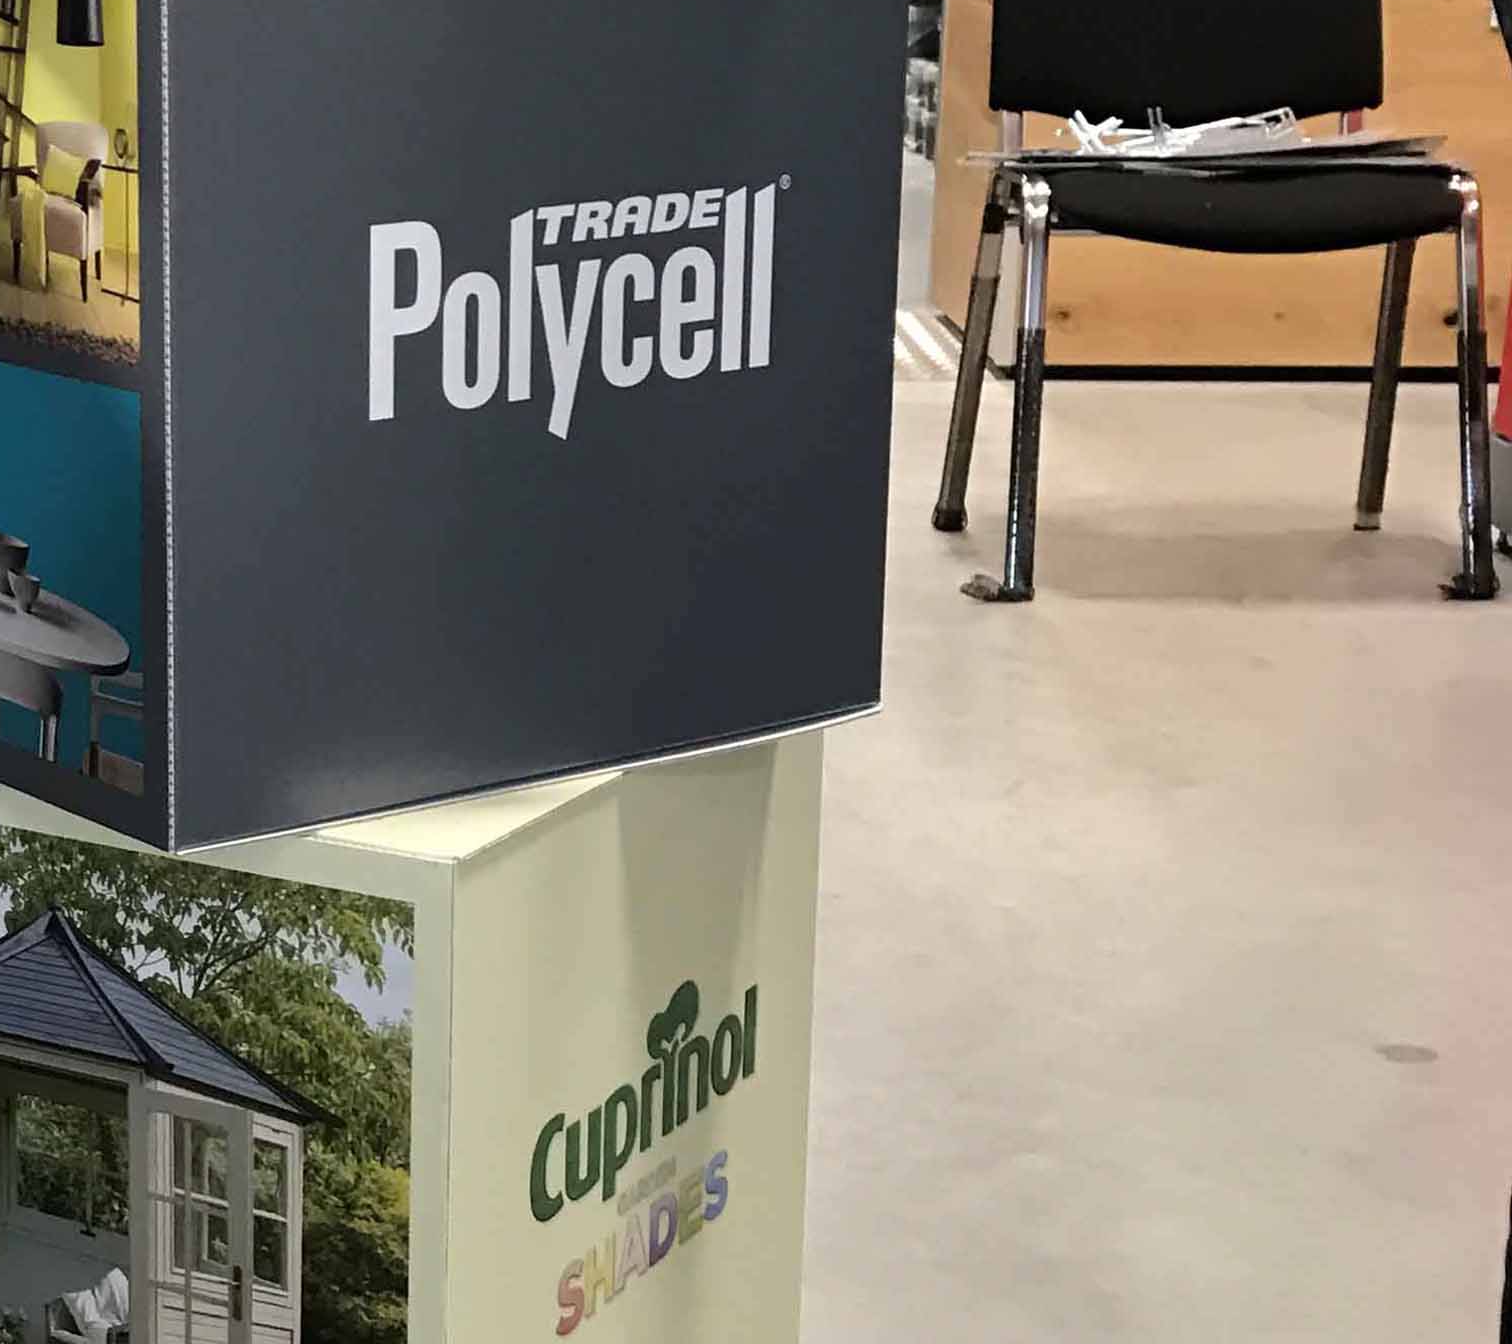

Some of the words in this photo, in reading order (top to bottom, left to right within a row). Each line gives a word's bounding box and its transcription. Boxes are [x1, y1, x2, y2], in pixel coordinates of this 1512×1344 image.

[368, 182, 776, 441] Polycell
[535, 188, 725, 246] TRADE
[529, 980, 758, 1223] Cuprinol
[555, 1149, 729, 1337] SHADES
